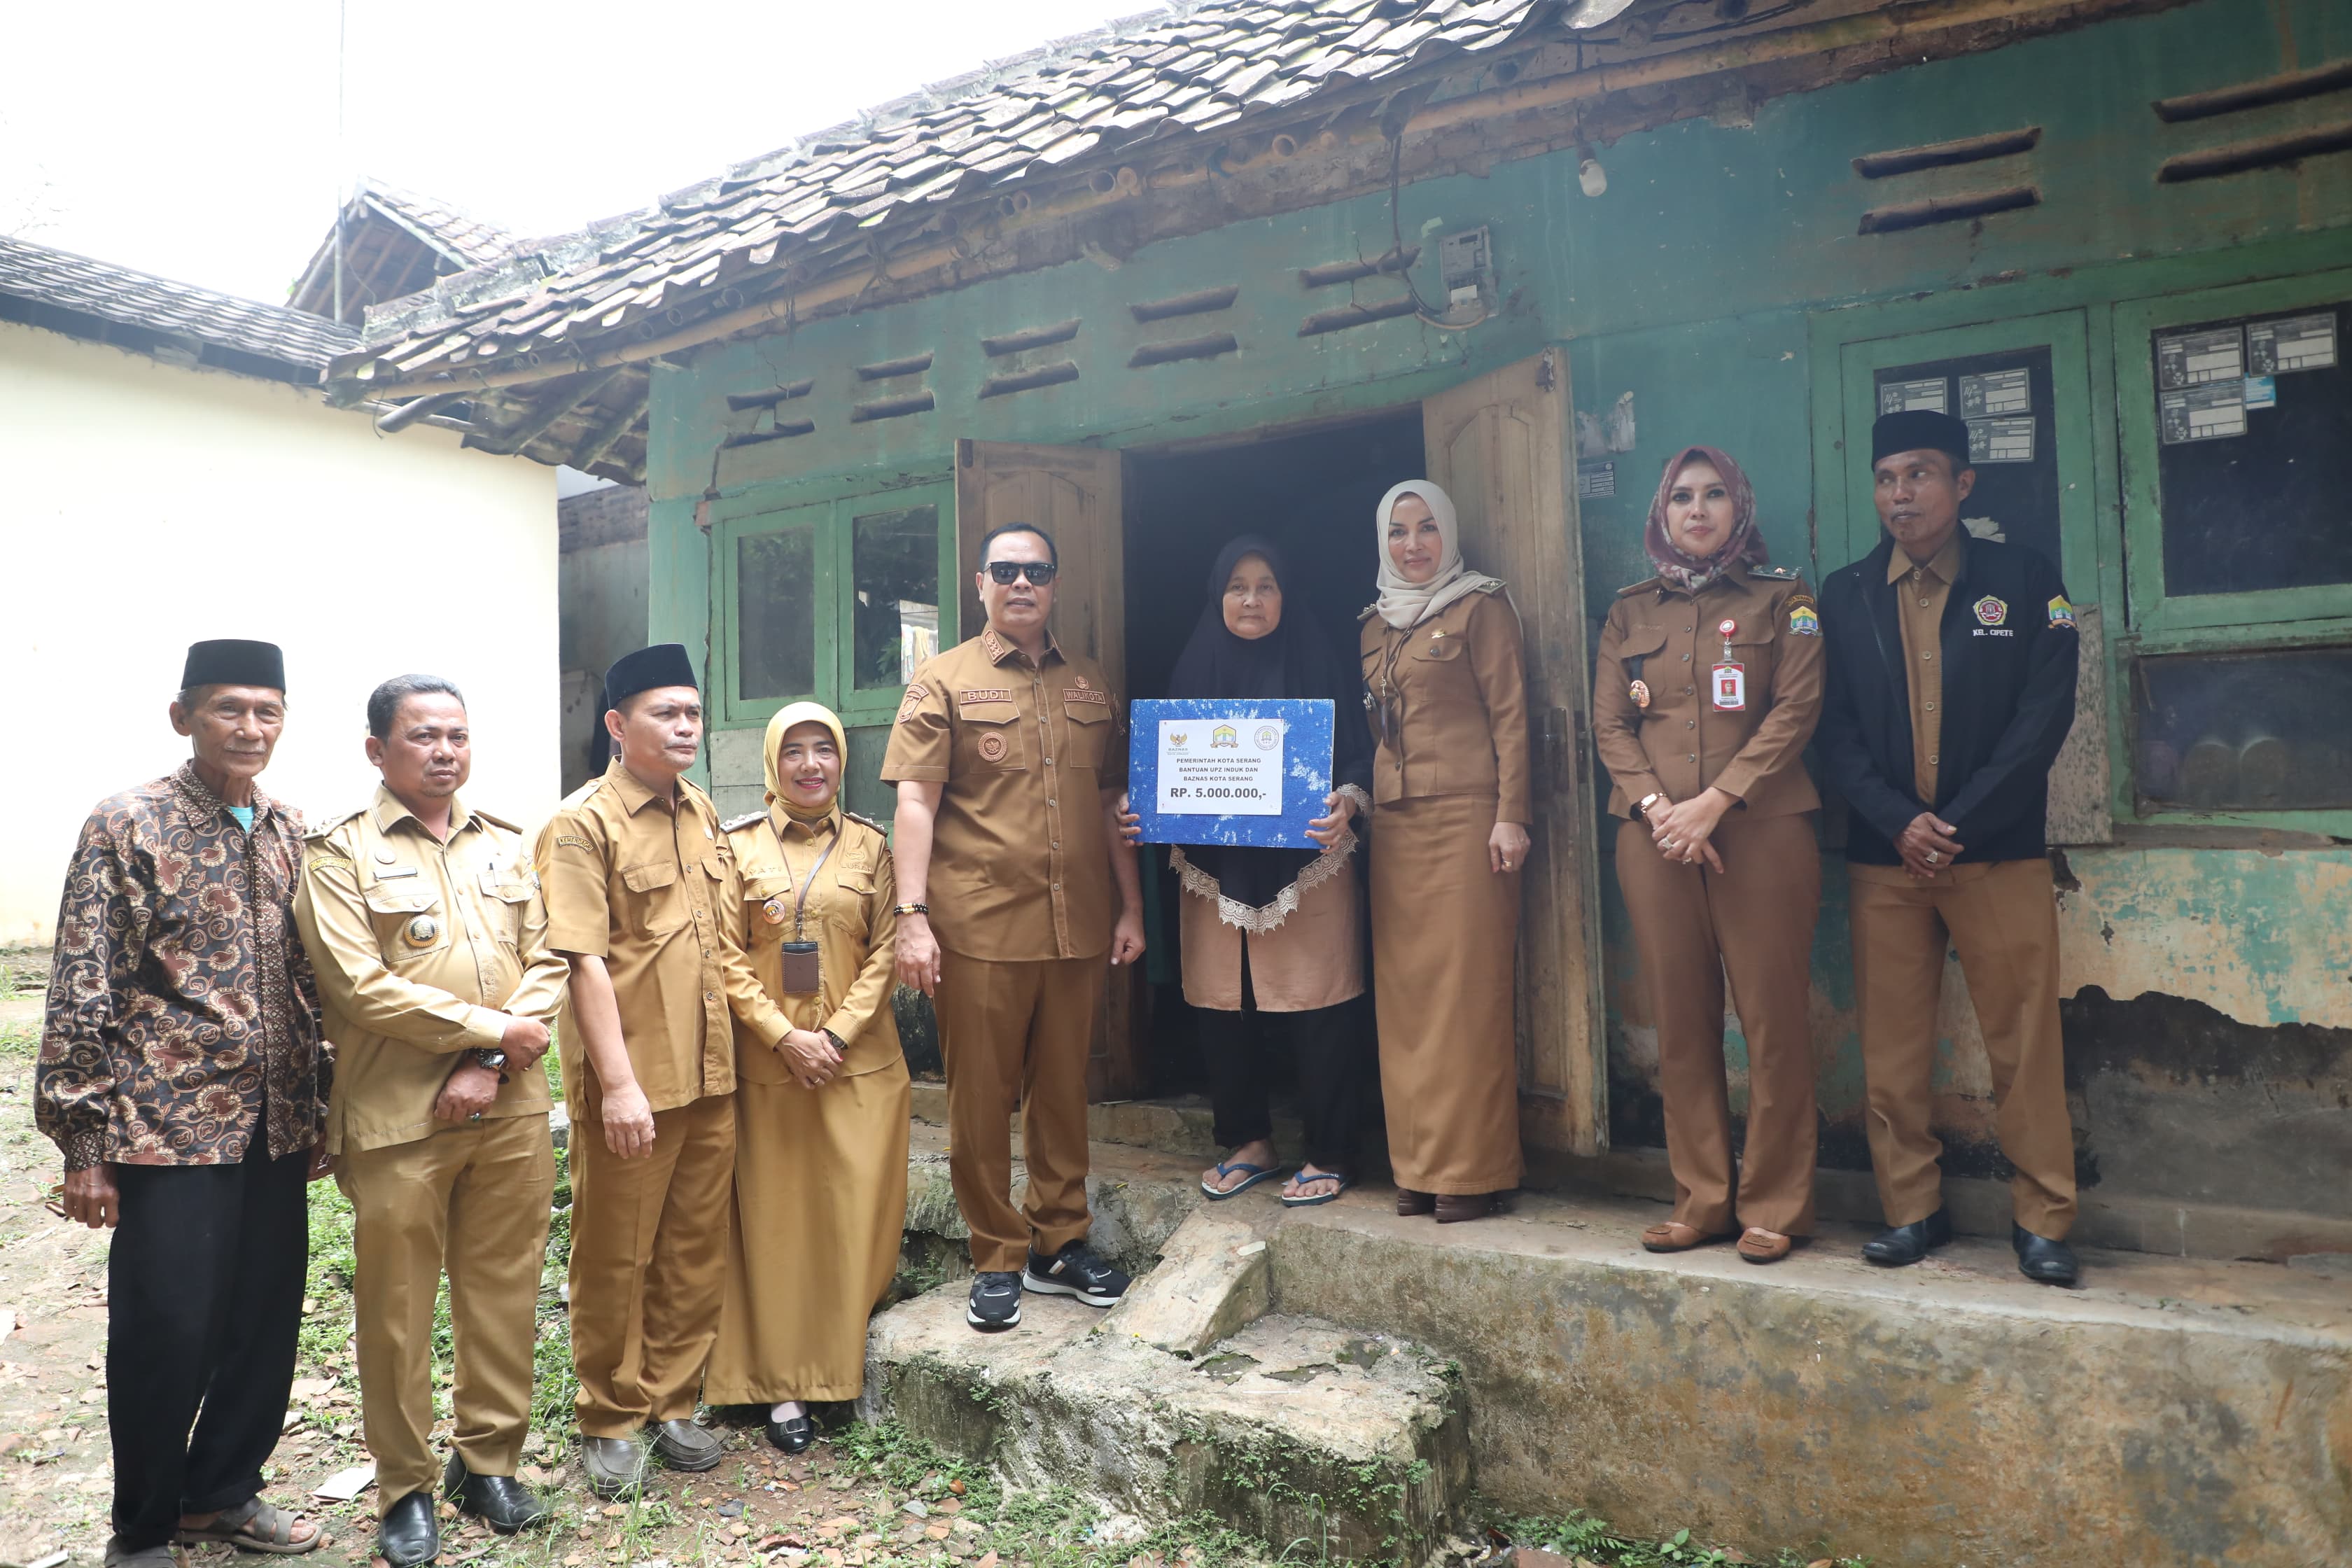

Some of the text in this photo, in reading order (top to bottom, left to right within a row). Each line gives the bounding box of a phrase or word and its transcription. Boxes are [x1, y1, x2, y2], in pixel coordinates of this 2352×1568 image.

[967, 690, 1004, 701] BUDI
[1065, 690, 1103, 702] WALIKOTA
[1170, 788, 1266, 800] RP. 5.000.000,-
[840, 862, 874, 874] LURAH
